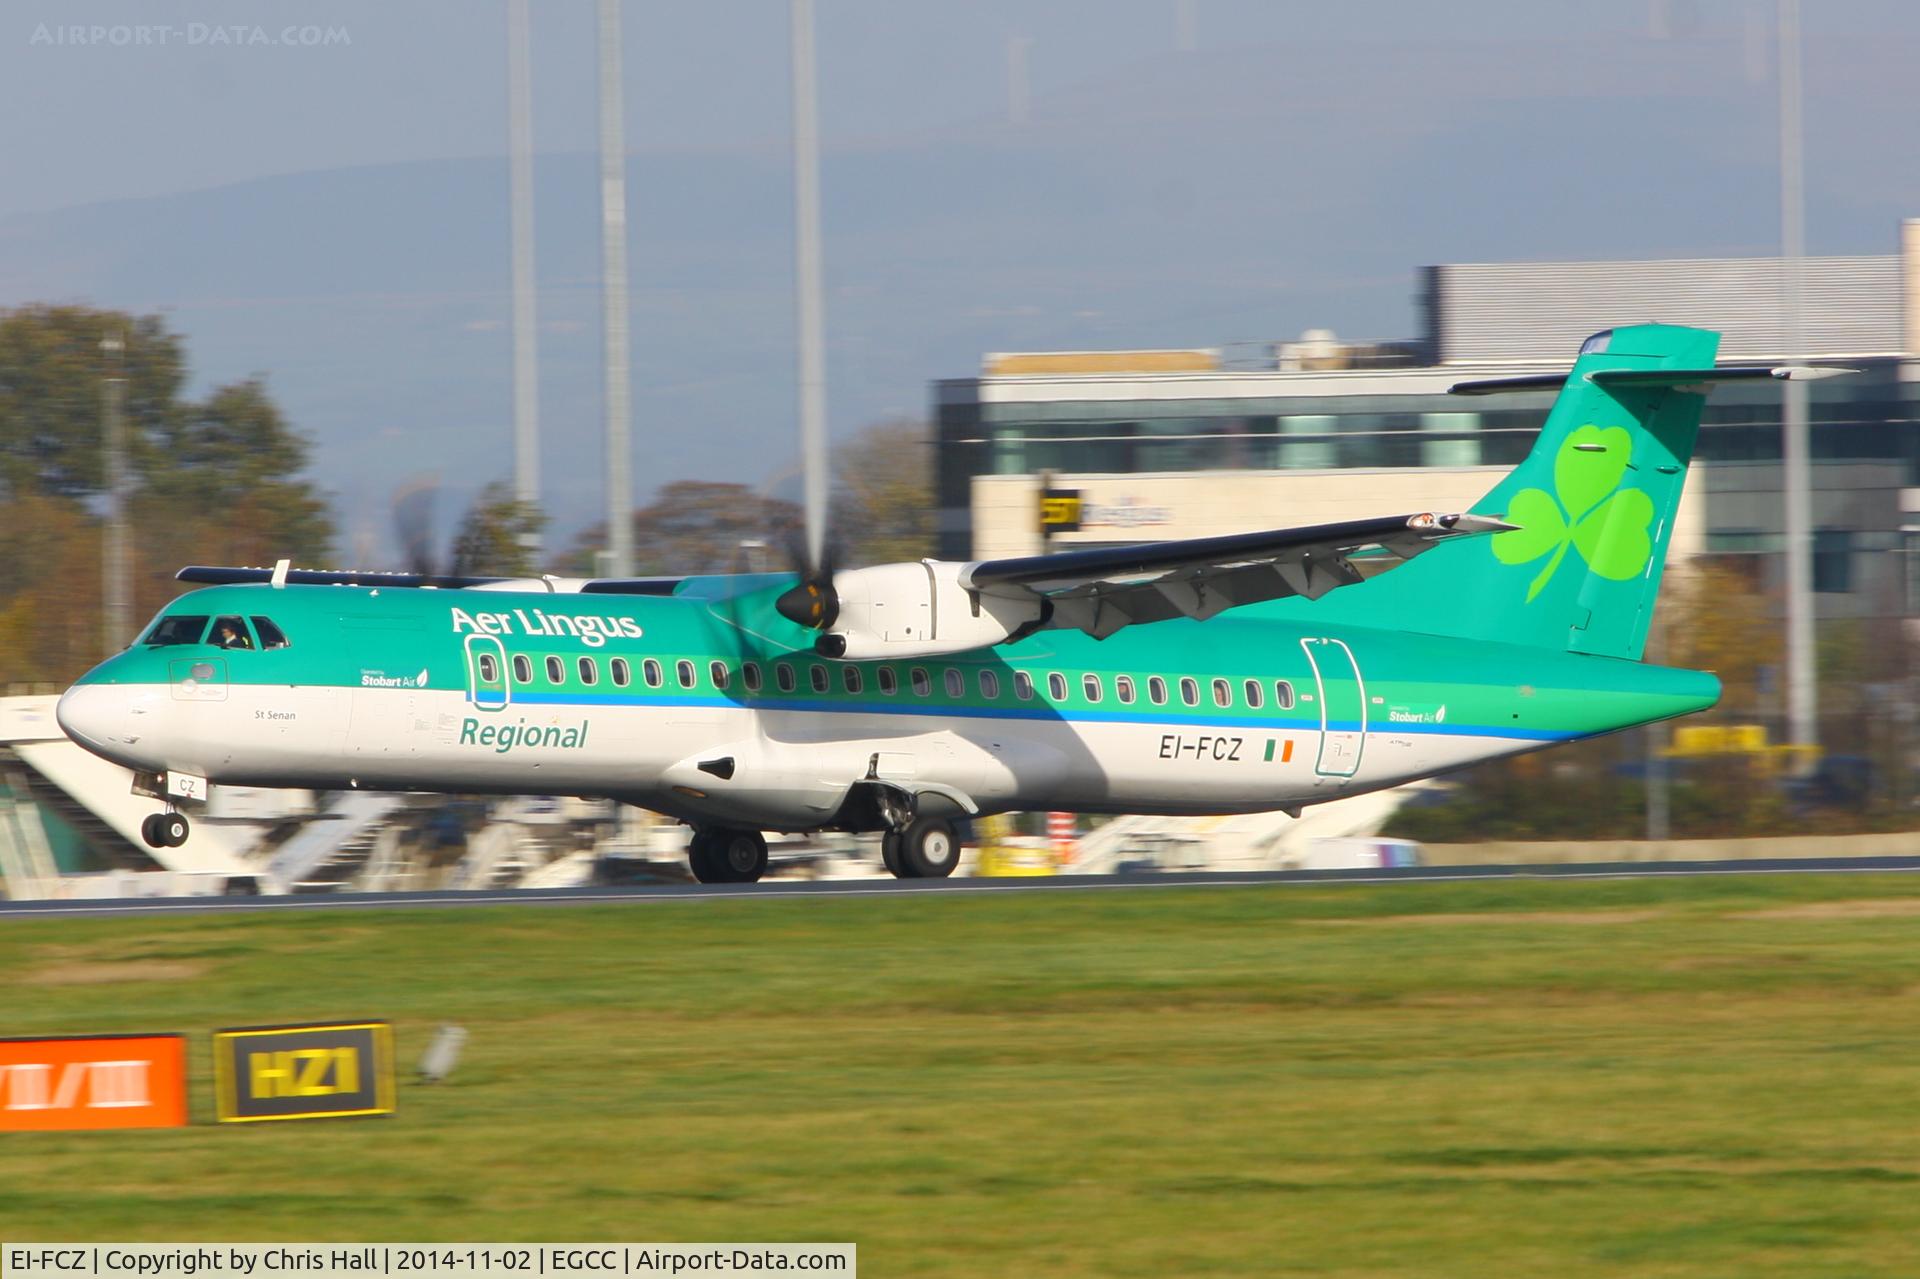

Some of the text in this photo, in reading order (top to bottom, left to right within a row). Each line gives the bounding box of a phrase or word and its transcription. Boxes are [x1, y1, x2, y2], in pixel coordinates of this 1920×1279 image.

[451, 608, 643, 647] Aer Lingus
[361, 675, 415, 687] Stobart Air
[255, 710, 296, 720] St Senan
[1389, 711, 1435, 723] Stobart Air
[459, 717, 588, 753] Regional
[1159, 735, 1243, 761] EI-FCZ
[180, 779, 195, 793] CZ
[249, 1046, 360, 1099] HZ1
